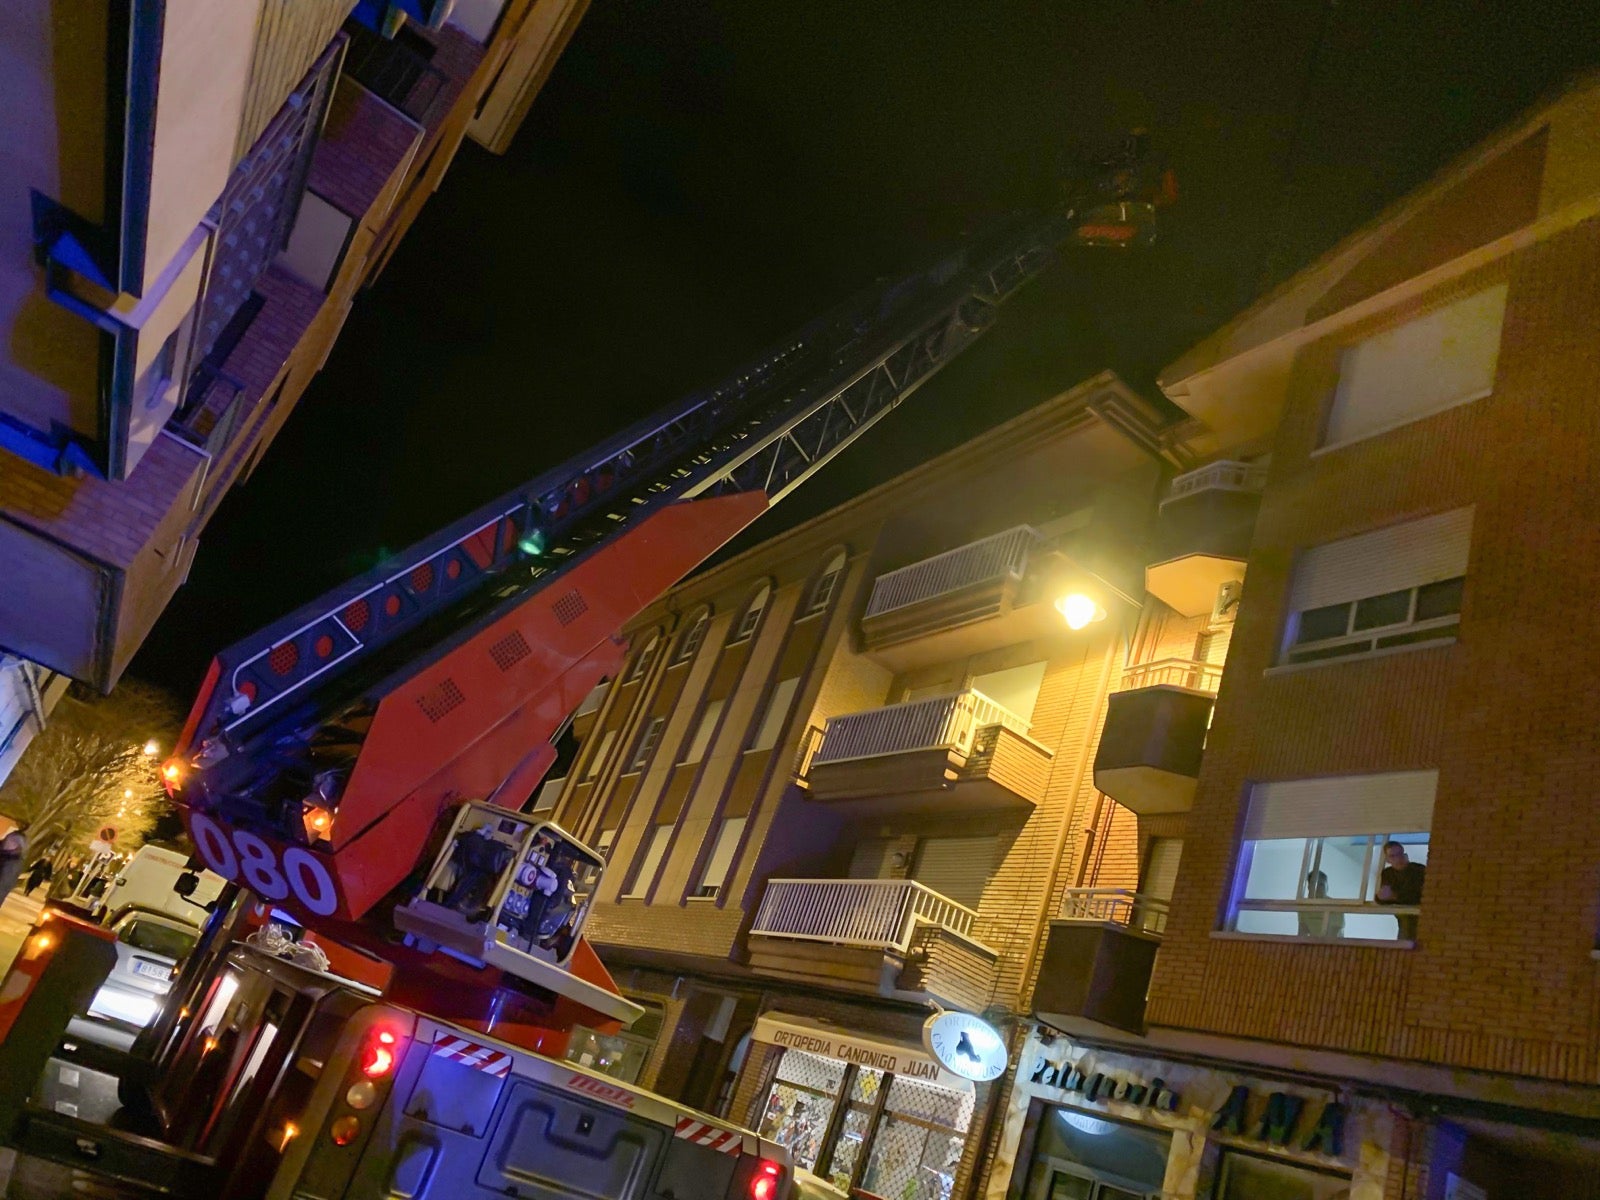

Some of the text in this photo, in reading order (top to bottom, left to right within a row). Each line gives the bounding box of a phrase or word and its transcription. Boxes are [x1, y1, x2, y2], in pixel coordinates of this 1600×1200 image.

[190, 813, 338, 916] 080
[773, 1030, 940, 1081] ORTOPEDIA CANONIGO JUAN
[567, 1073, 635, 1108] Metz
